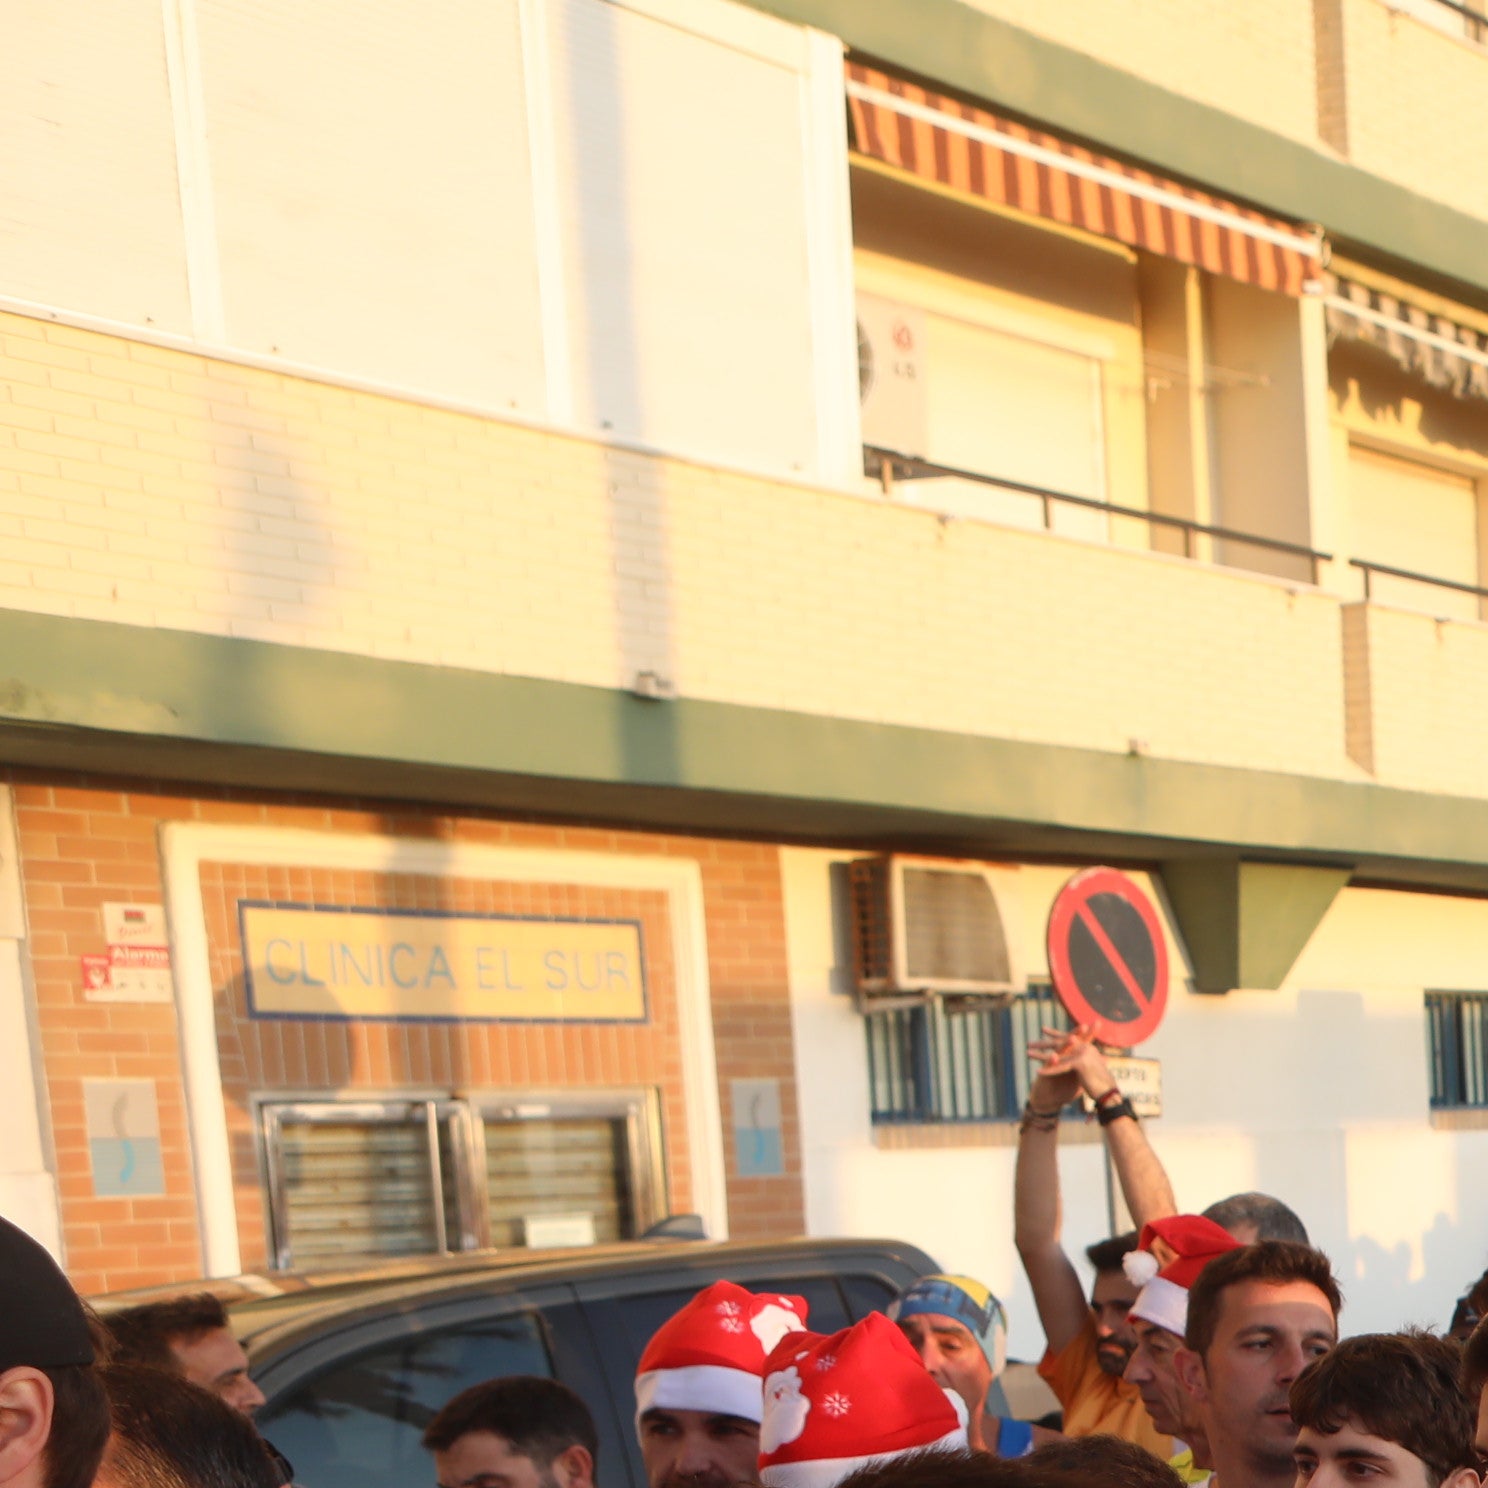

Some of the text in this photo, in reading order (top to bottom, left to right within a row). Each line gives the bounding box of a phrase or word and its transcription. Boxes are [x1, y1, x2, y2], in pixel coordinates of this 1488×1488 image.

[264, 937, 632, 993] CLINICA EL SUR
